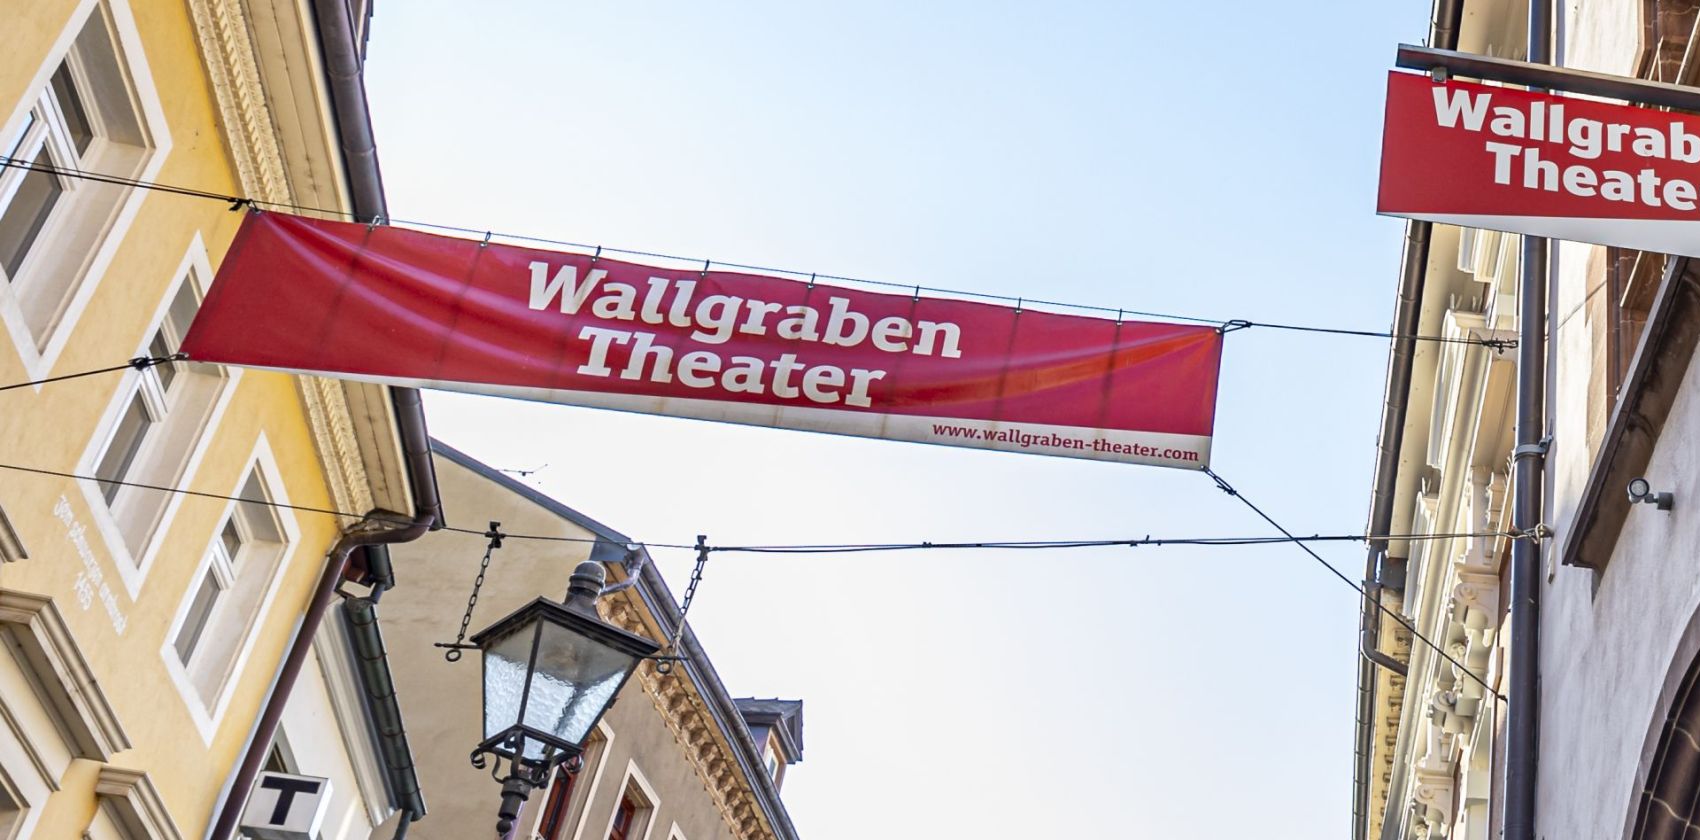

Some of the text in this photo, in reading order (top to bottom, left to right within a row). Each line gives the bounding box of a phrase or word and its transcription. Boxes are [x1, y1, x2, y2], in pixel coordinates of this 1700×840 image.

[527, 261, 962, 359] Wallgraben
[577, 325, 886, 408] Theater
[932, 423, 1199, 462] www.wallgraben-theater.com
[261, 776, 321, 826] T
